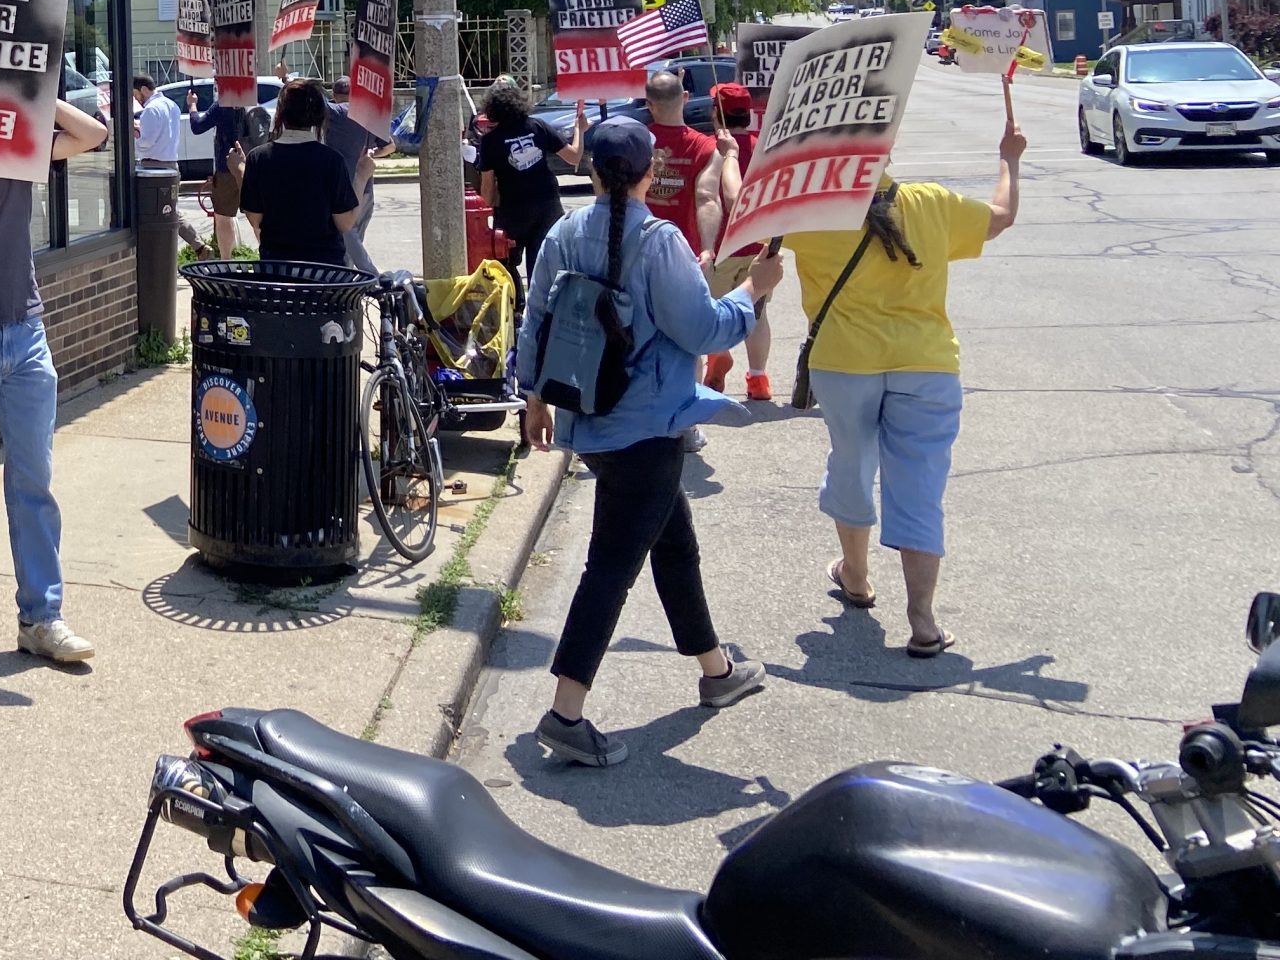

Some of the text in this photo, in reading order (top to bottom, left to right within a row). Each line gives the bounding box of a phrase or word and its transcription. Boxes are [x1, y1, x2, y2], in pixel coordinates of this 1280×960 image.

[215, 2, 252, 26] PRACTICE
[273, 7, 315, 33] STRIKE
[964, 26, 1001, 39] Come
[178, 43, 211, 62] STRIKE
[558, 48, 631, 73] STRIK
[756, 41, 787, 56] UNF
[998, 44, 1017, 55] Lin
[215, 49, 254, 77] STRIKE
[792, 45, 884, 88] UNFAIR
[786, 74, 862, 113] LABOR
[768, 98, 890, 146] PRACTICE
[736, 156, 880, 218] STRIKE
[203, 376, 241, 396] DISCOVER
[204, 408, 239, 426] AVENUE
[225, 421, 256, 458] EXPLORE
[174, 799, 205, 820] SCORPION
